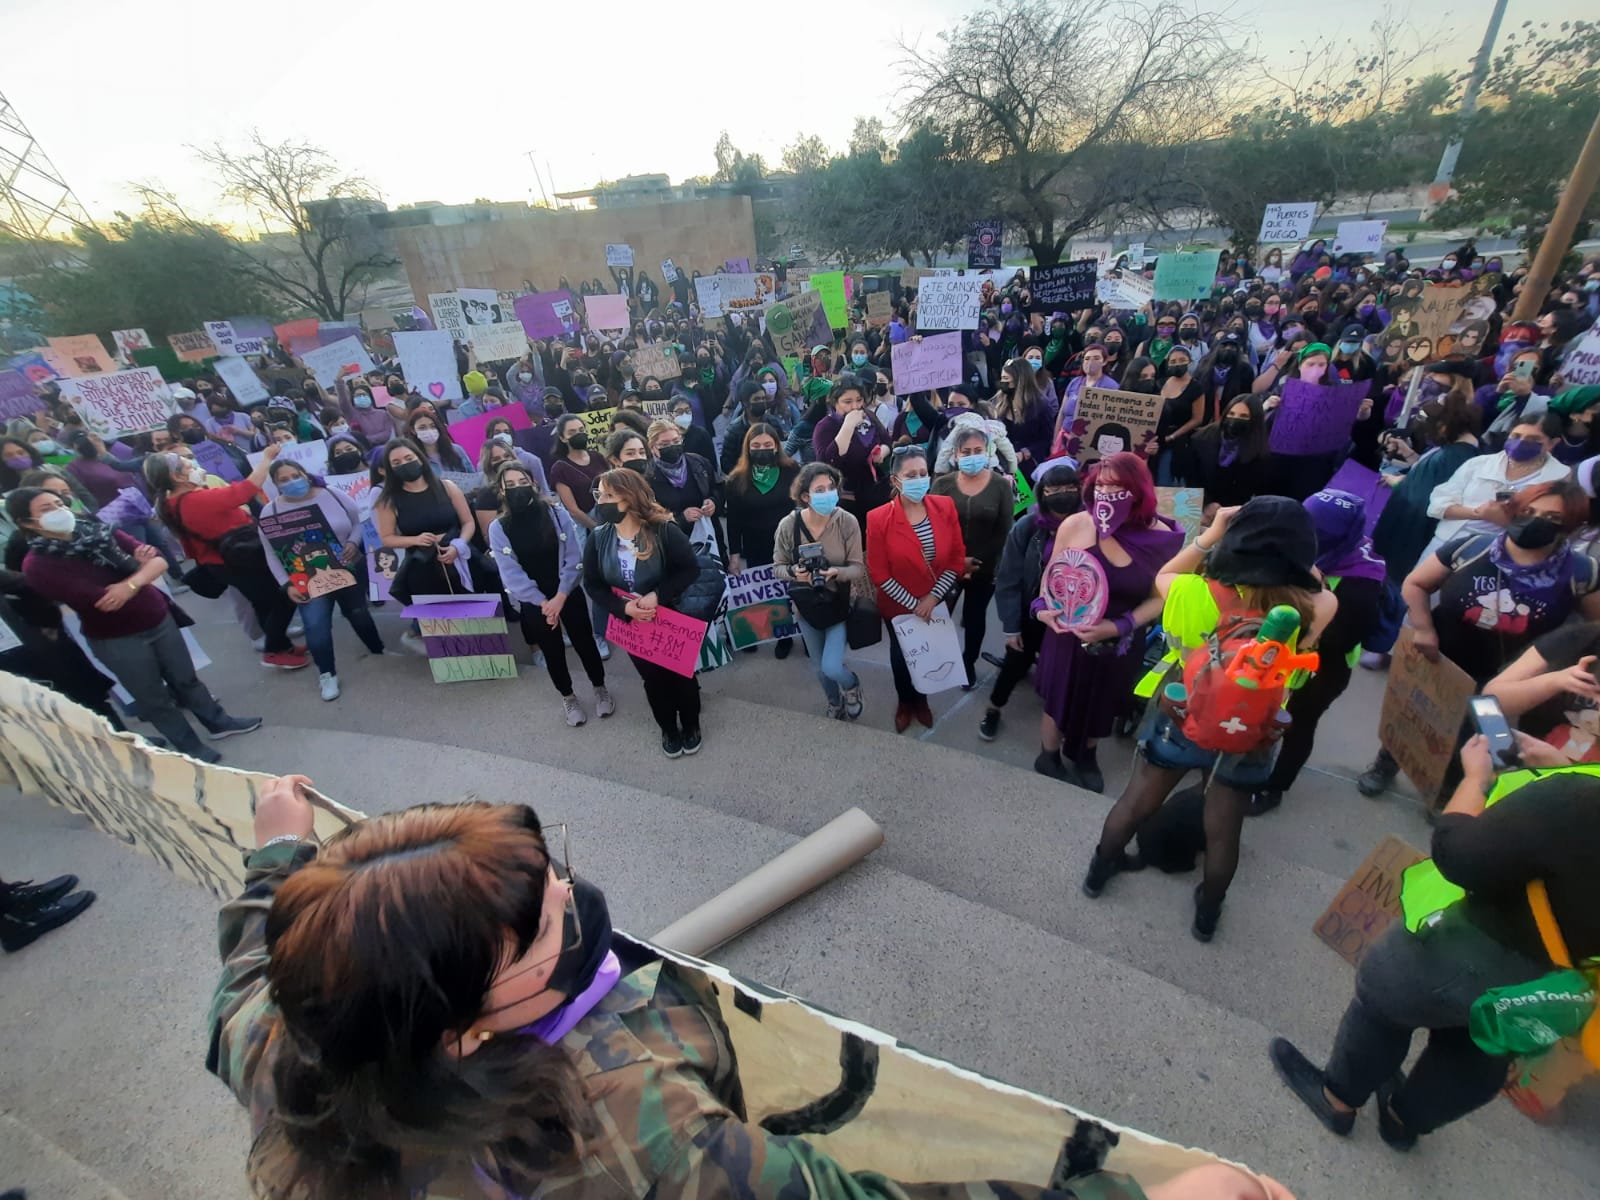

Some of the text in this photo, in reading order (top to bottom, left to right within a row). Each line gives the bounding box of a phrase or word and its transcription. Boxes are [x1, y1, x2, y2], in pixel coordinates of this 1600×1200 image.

[1276, 210, 1309, 220] FUERTES
[1266, 219, 1297, 229] QUE EL
[1263, 229, 1298, 240] FUEGO
[1034, 269, 1051, 280] LAS
[946, 281, 981, 293] CANSAS
[921, 294, 932, 304] DE
[920, 304, 979, 319] NOSOTRAS DE
[210, 322, 228, 330] POR
[923, 316, 960, 329] VIVIRLO
[215, 330, 233, 338] QUE
[1085, 389, 1157, 408] En memoria de
[1077, 409, 1089, 417] las
[1091, 412, 1104, 420] que
[1079, 400, 1100, 410] todas
[1104, 402, 1117, 412] las
[1119, 405, 1144, 417] niñas
[587, 411, 612, 425] Sobr
[1472, 575, 1496, 591] YES
[732, 591, 753, 607] MI
[650, 630, 686, 655] #8M
